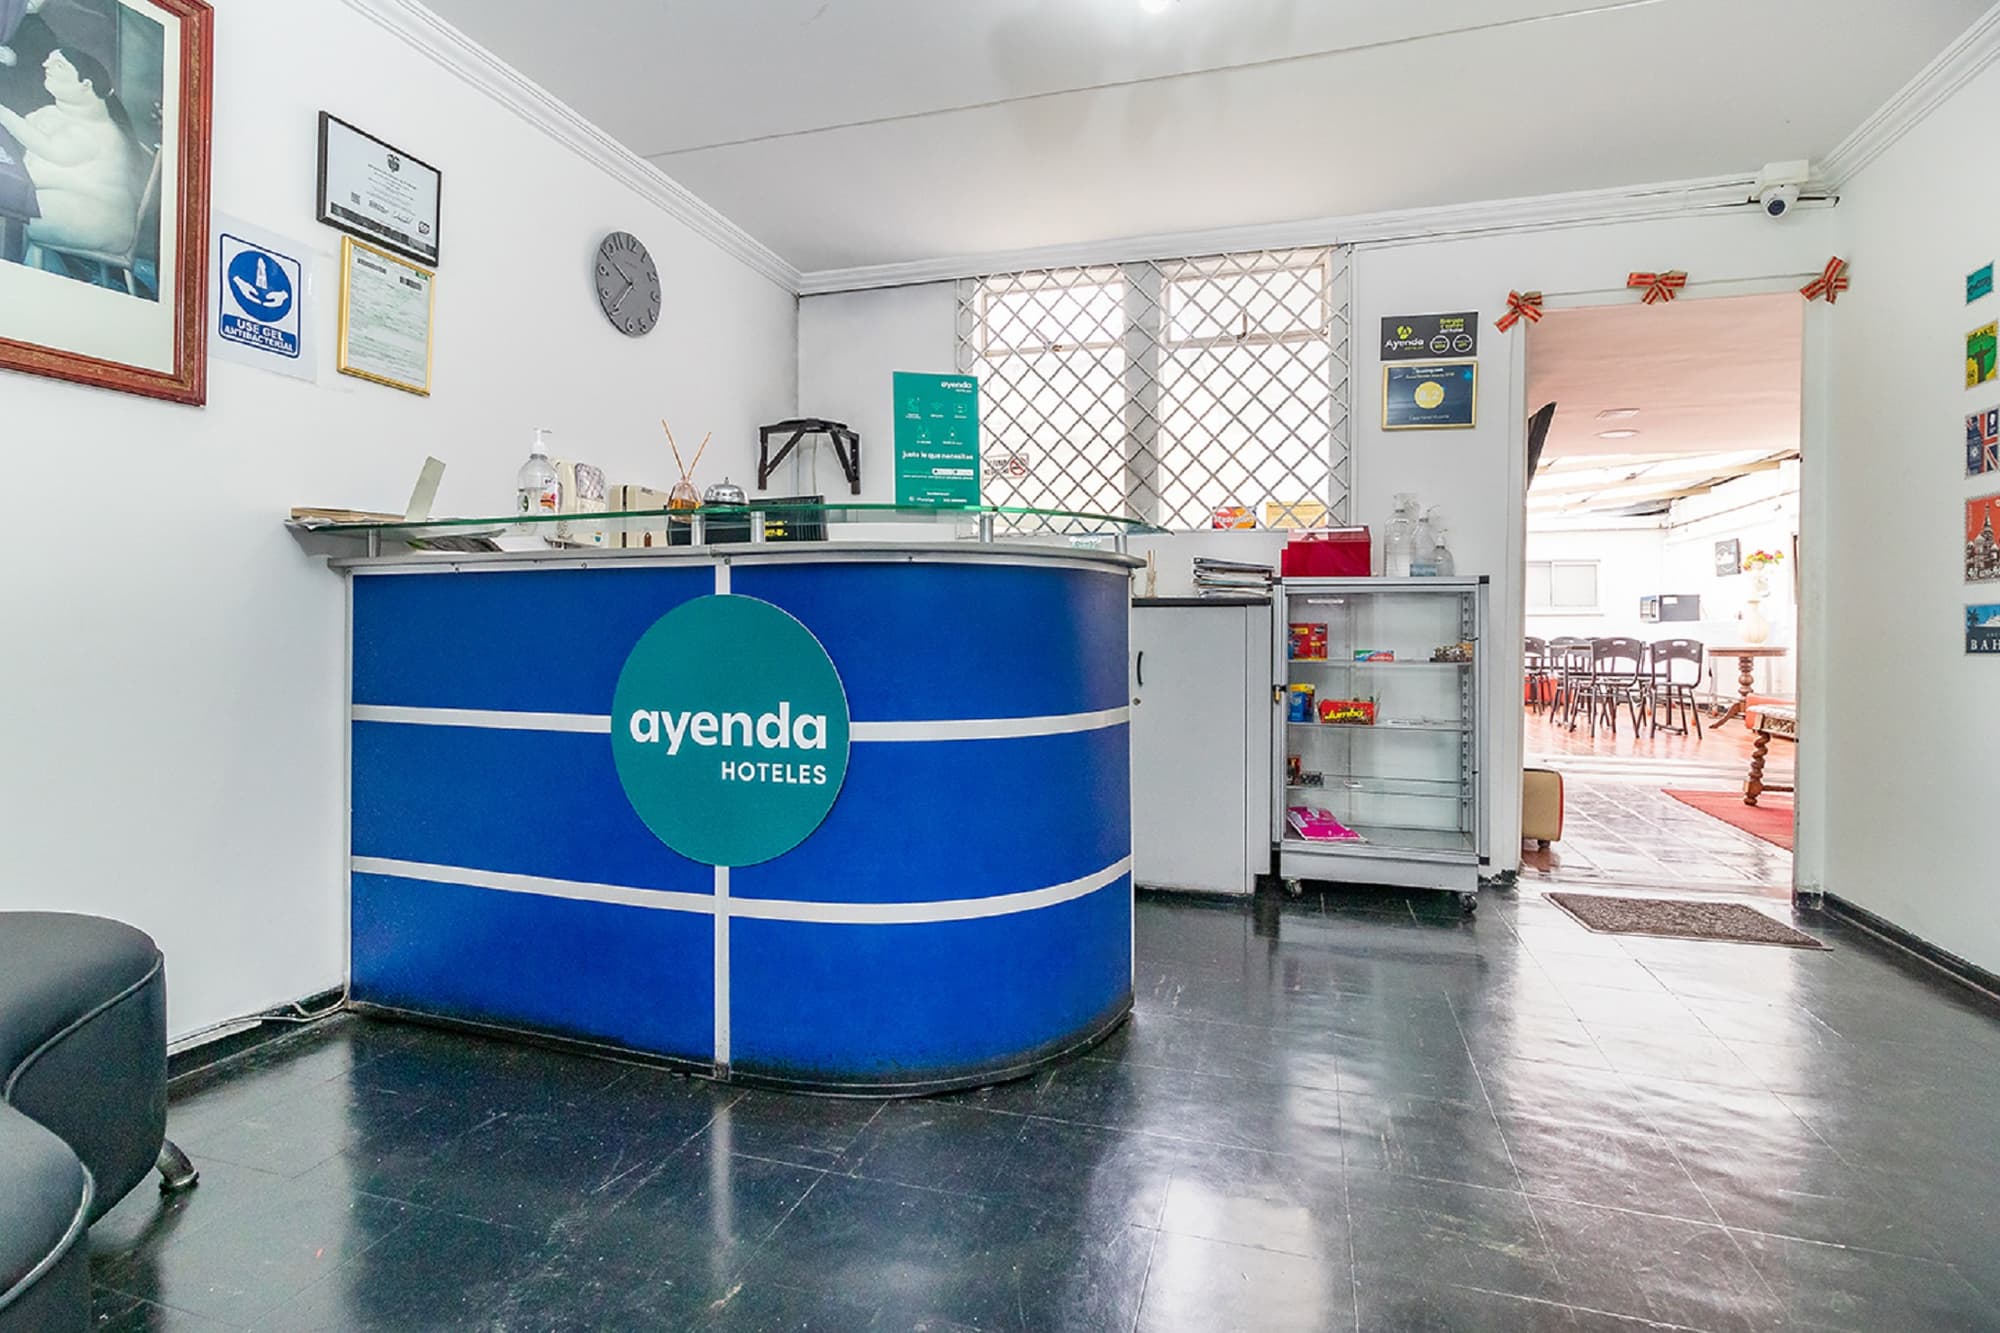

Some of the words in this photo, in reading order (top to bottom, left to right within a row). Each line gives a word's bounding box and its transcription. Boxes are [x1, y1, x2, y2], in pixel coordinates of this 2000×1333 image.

[224, 324, 293, 351] ANTIBACTERIAL
[236, 318, 260, 334] USE
[262, 326, 284, 341] GEL
[1384, 338, 1424, 351] Ayenda
[1970, 639, 2000, 651] BAH
[1323, 707, 1365, 720] Jumbo
[629, 701, 827, 756] ayenda
[721, 761, 827, 785] HOTELES
